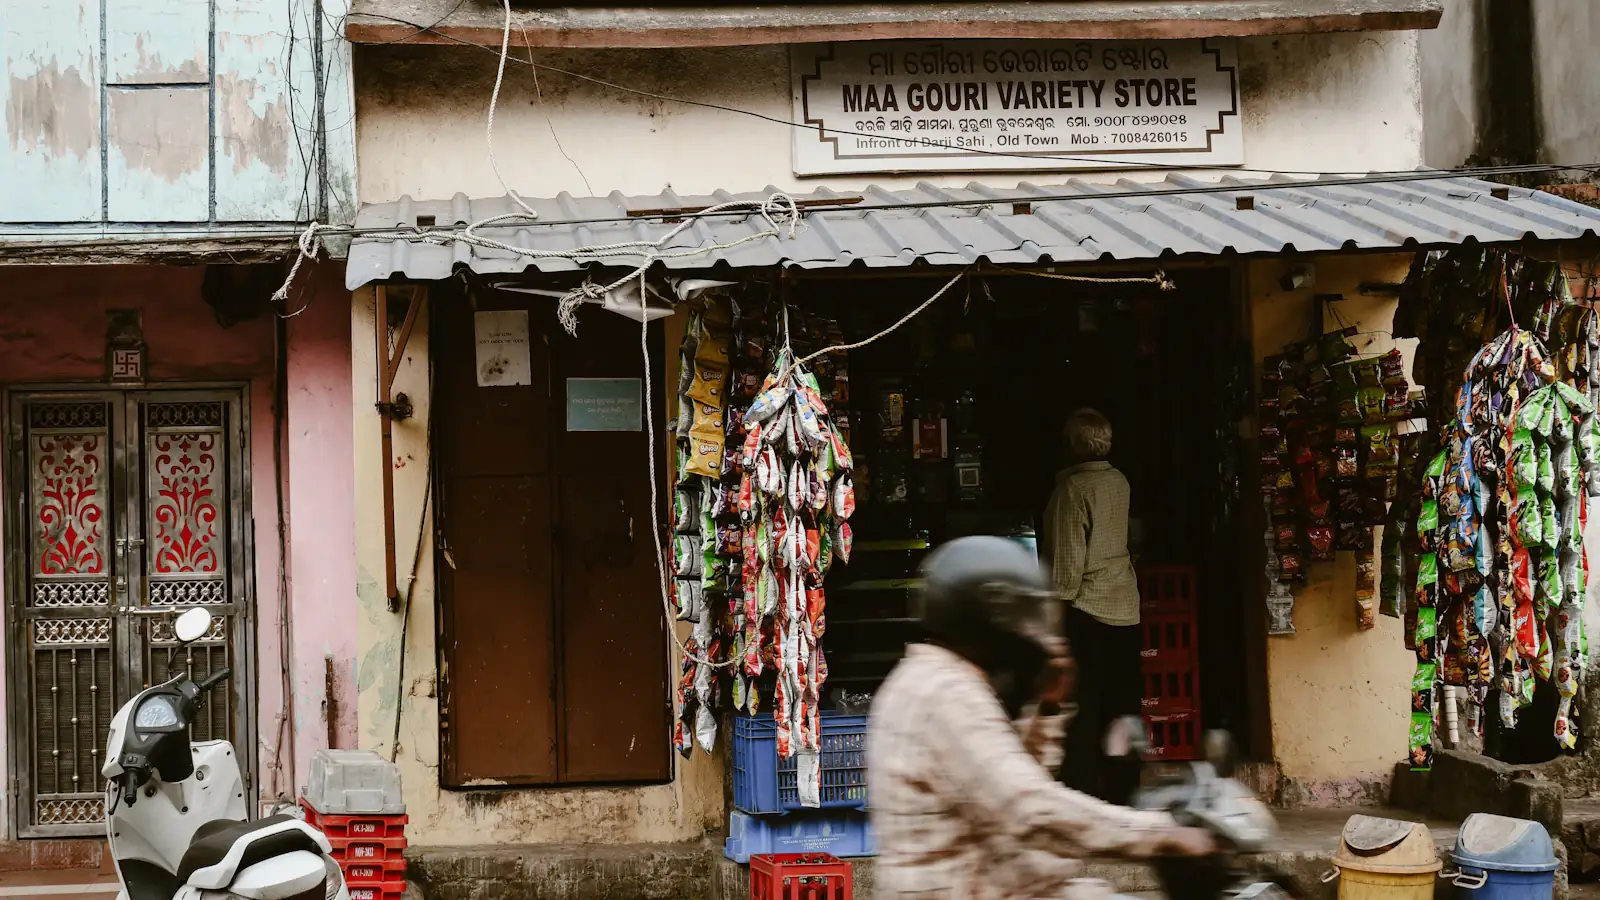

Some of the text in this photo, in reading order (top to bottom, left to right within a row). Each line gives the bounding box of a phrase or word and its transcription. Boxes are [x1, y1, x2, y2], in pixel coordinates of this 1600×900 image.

[868, 51, 895, 76] ମା
[903, 43, 975, 75] ଗୌରୀ
[982, 42, 1093, 74] ଭେରାଇଟି
[842, 77, 1198, 113] MAA GOURI VARIETY STORE
[855, 116, 886, 131] ଦରଜି
[890, 115, 913, 132] ସାହି
[958, 118, 993, 132] ପୁରୁଣା
[1066, 116, 1090, 128] ମୋ.
[1094, 114, 1188, 128] ୭୦୦୮୪୨୬୦୧୫
[856, 137, 904, 149] Infront
[904, 136, 919, 148] of
[921, 136, 952, 150] Darji
[956, 135, 985, 148] Sahi
[997, 134, 1020, 146] Old
[1023, 133, 1059, 146] Town
[1071, 132, 1099, 145] Mob
[1111, 131, 1188, 144] 7008426015
